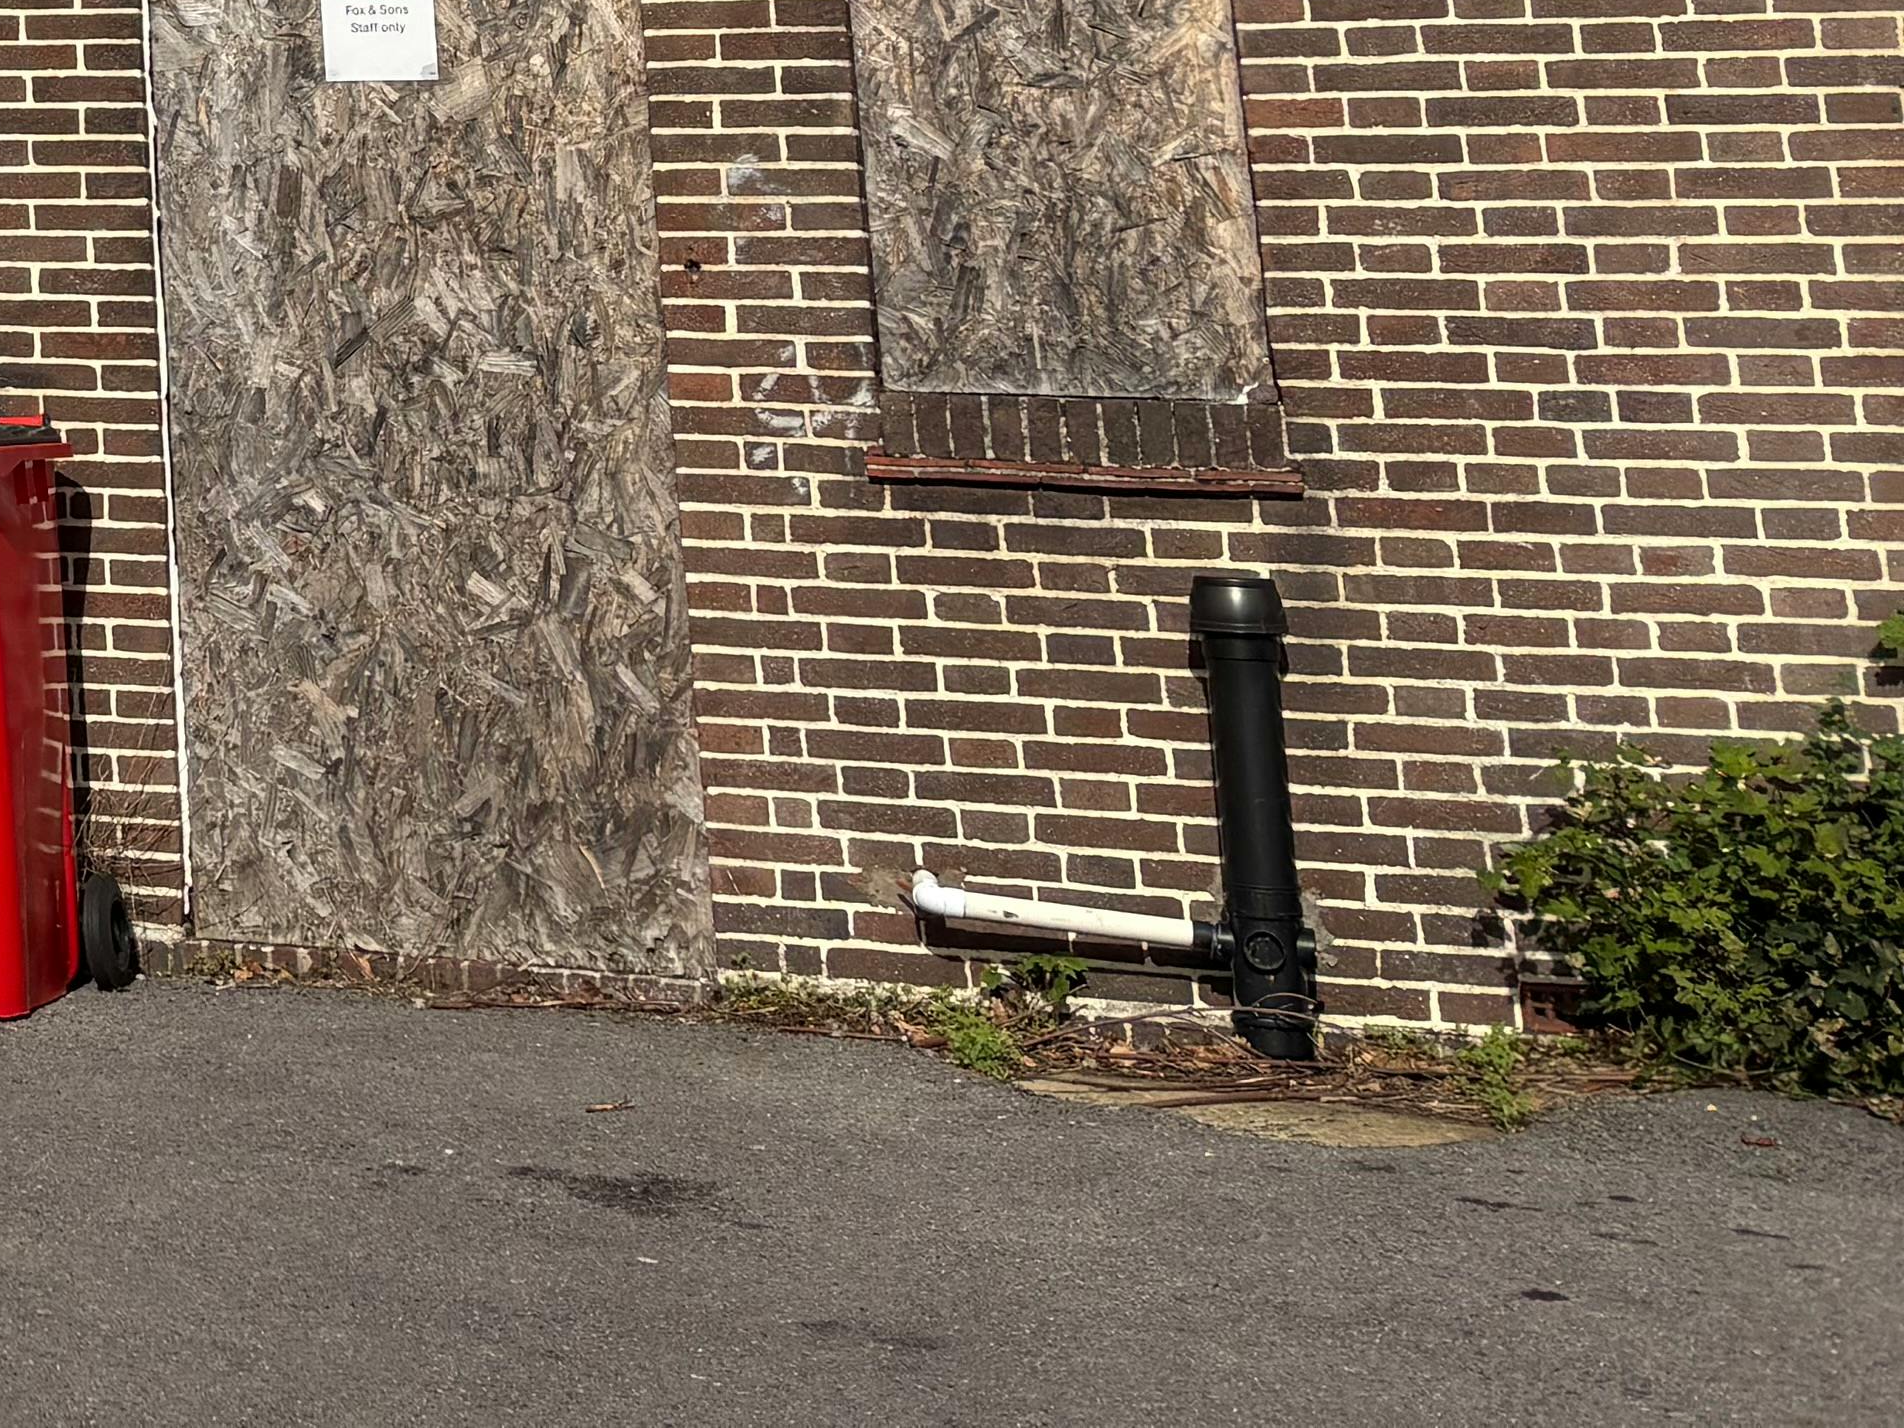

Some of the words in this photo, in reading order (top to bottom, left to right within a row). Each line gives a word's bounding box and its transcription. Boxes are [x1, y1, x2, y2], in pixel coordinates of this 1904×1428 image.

[345, 5, 366, 16] Fox
[368, 5, 377, 15] &
[380, 4, 409, 15] Sons
[351, 22, 378, 33] Staff
[381, 22, 406, 34] only
